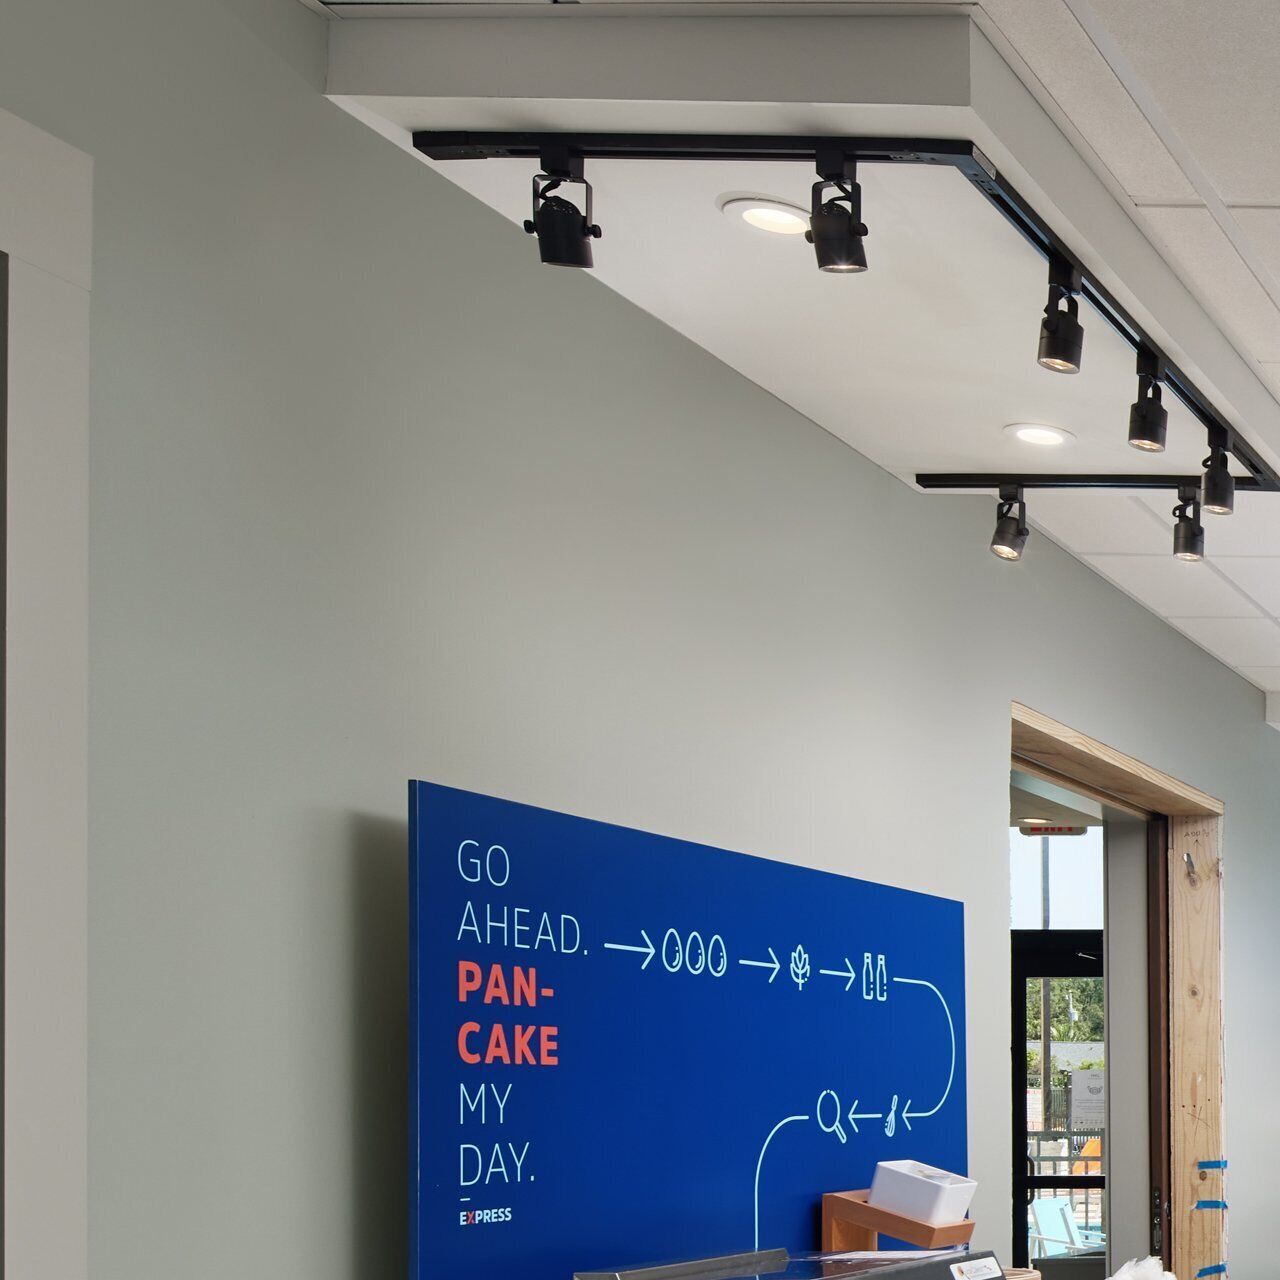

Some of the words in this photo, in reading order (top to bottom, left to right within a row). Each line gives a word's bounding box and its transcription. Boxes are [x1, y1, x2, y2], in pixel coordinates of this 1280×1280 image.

[457, 839, 510, 887] GO
[457, 900, 588, 955] AHEAD.
[457, 960, 554, 1007] PAN-
[457, 1021, 559, 1065] CAKE
[460, 1082, 513, 1124] MY
[460, 1141, 535, 1186] DAY.
[460, 1207, 512, 1226] EXPRESS
